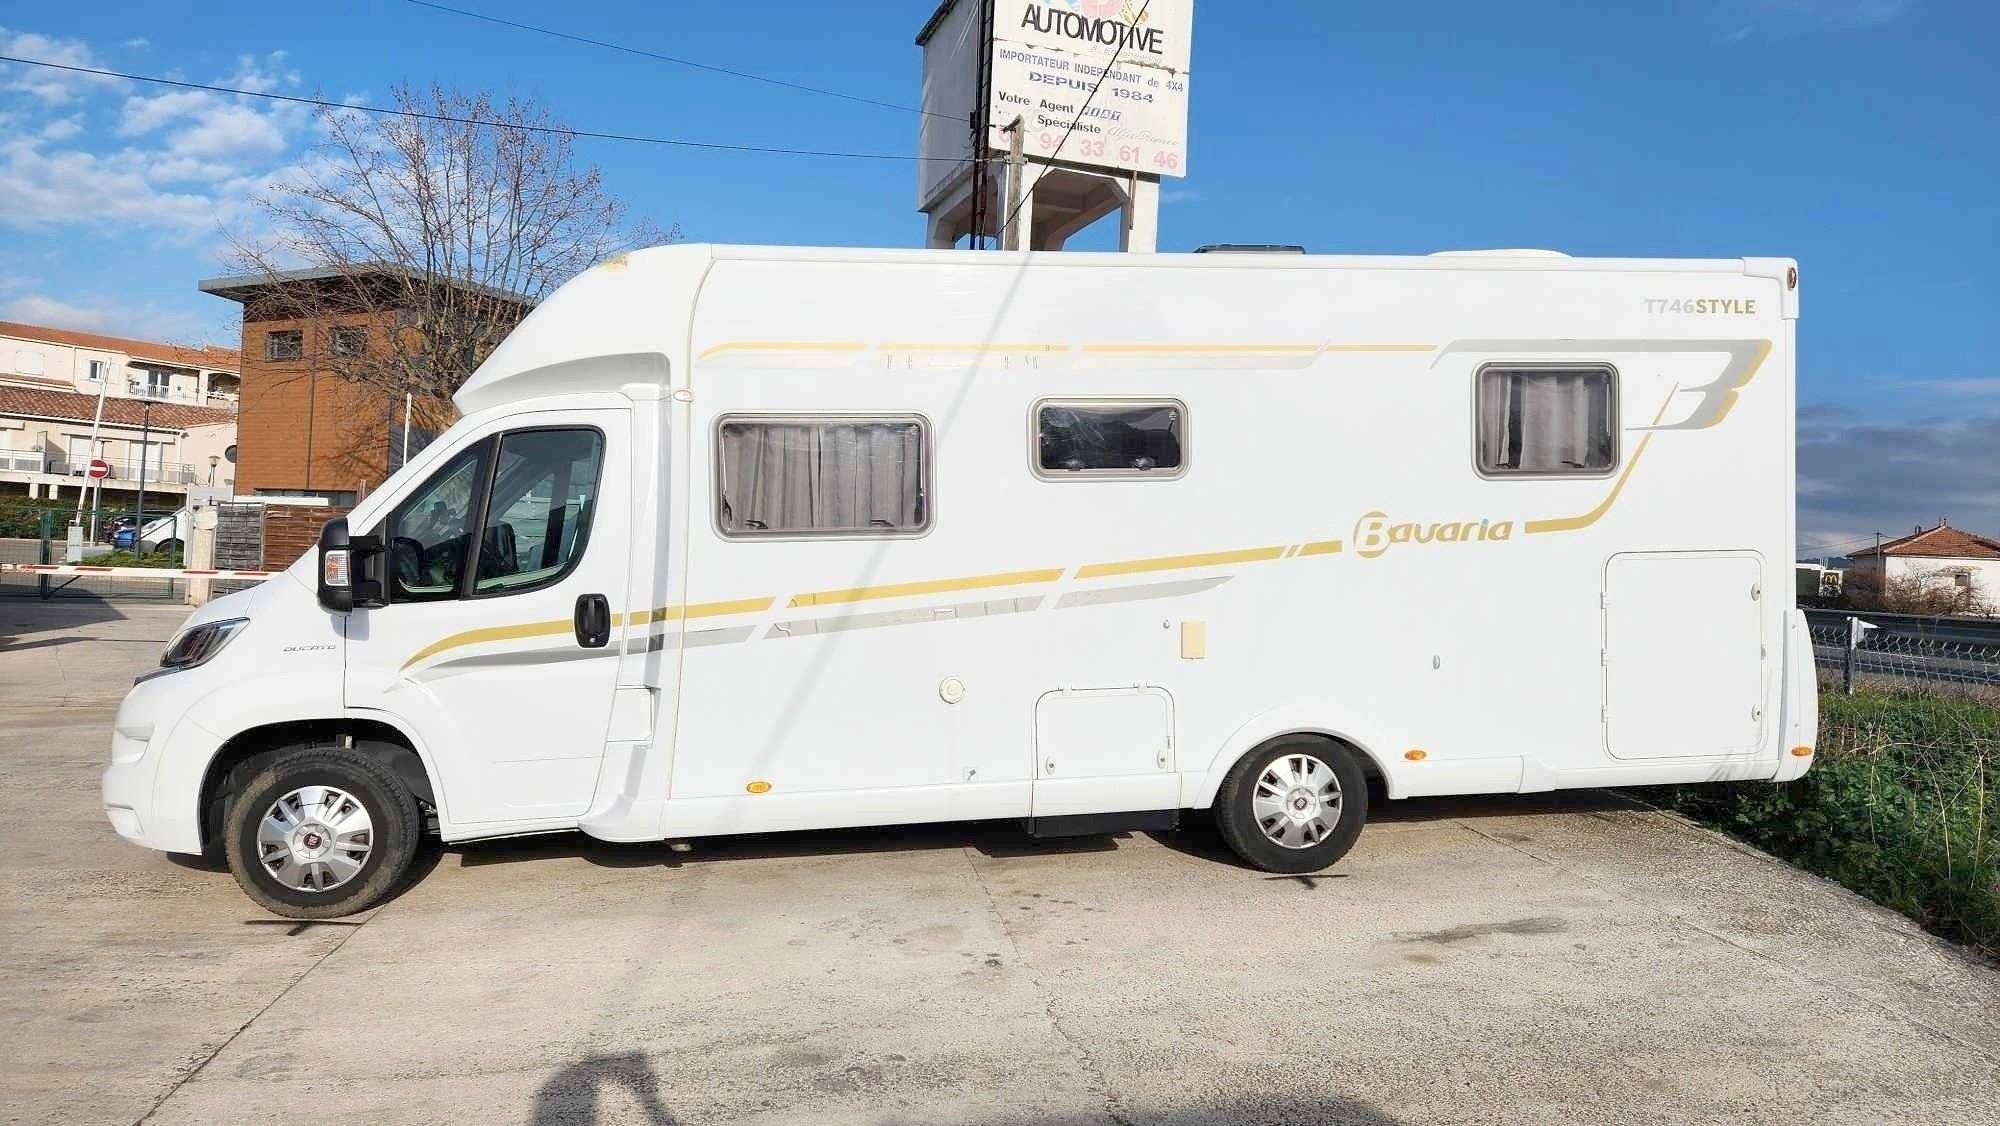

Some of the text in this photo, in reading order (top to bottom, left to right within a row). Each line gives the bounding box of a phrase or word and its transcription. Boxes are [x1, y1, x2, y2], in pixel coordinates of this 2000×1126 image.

[1021, 3, 1164, 54] AUTOMOTIVE
[1000, 49, 1069, 71] IMPORTATEUR
[1074, 63, 1142, 84] INDEPENDANT
[1147, 77, 1159, 88] de
[998, 90, 1031, 106] Votre
[1039, 98, 1075, 114] Agent
[1029, 71, 1154, 103] DEPUIS 1984
[1080, 139, 1105, 158] 33
[1119, 145, 1141, 164] 61
[1153, 151, 1178, 170] 46
[1352, 511, 1513, 559] Bavaria
